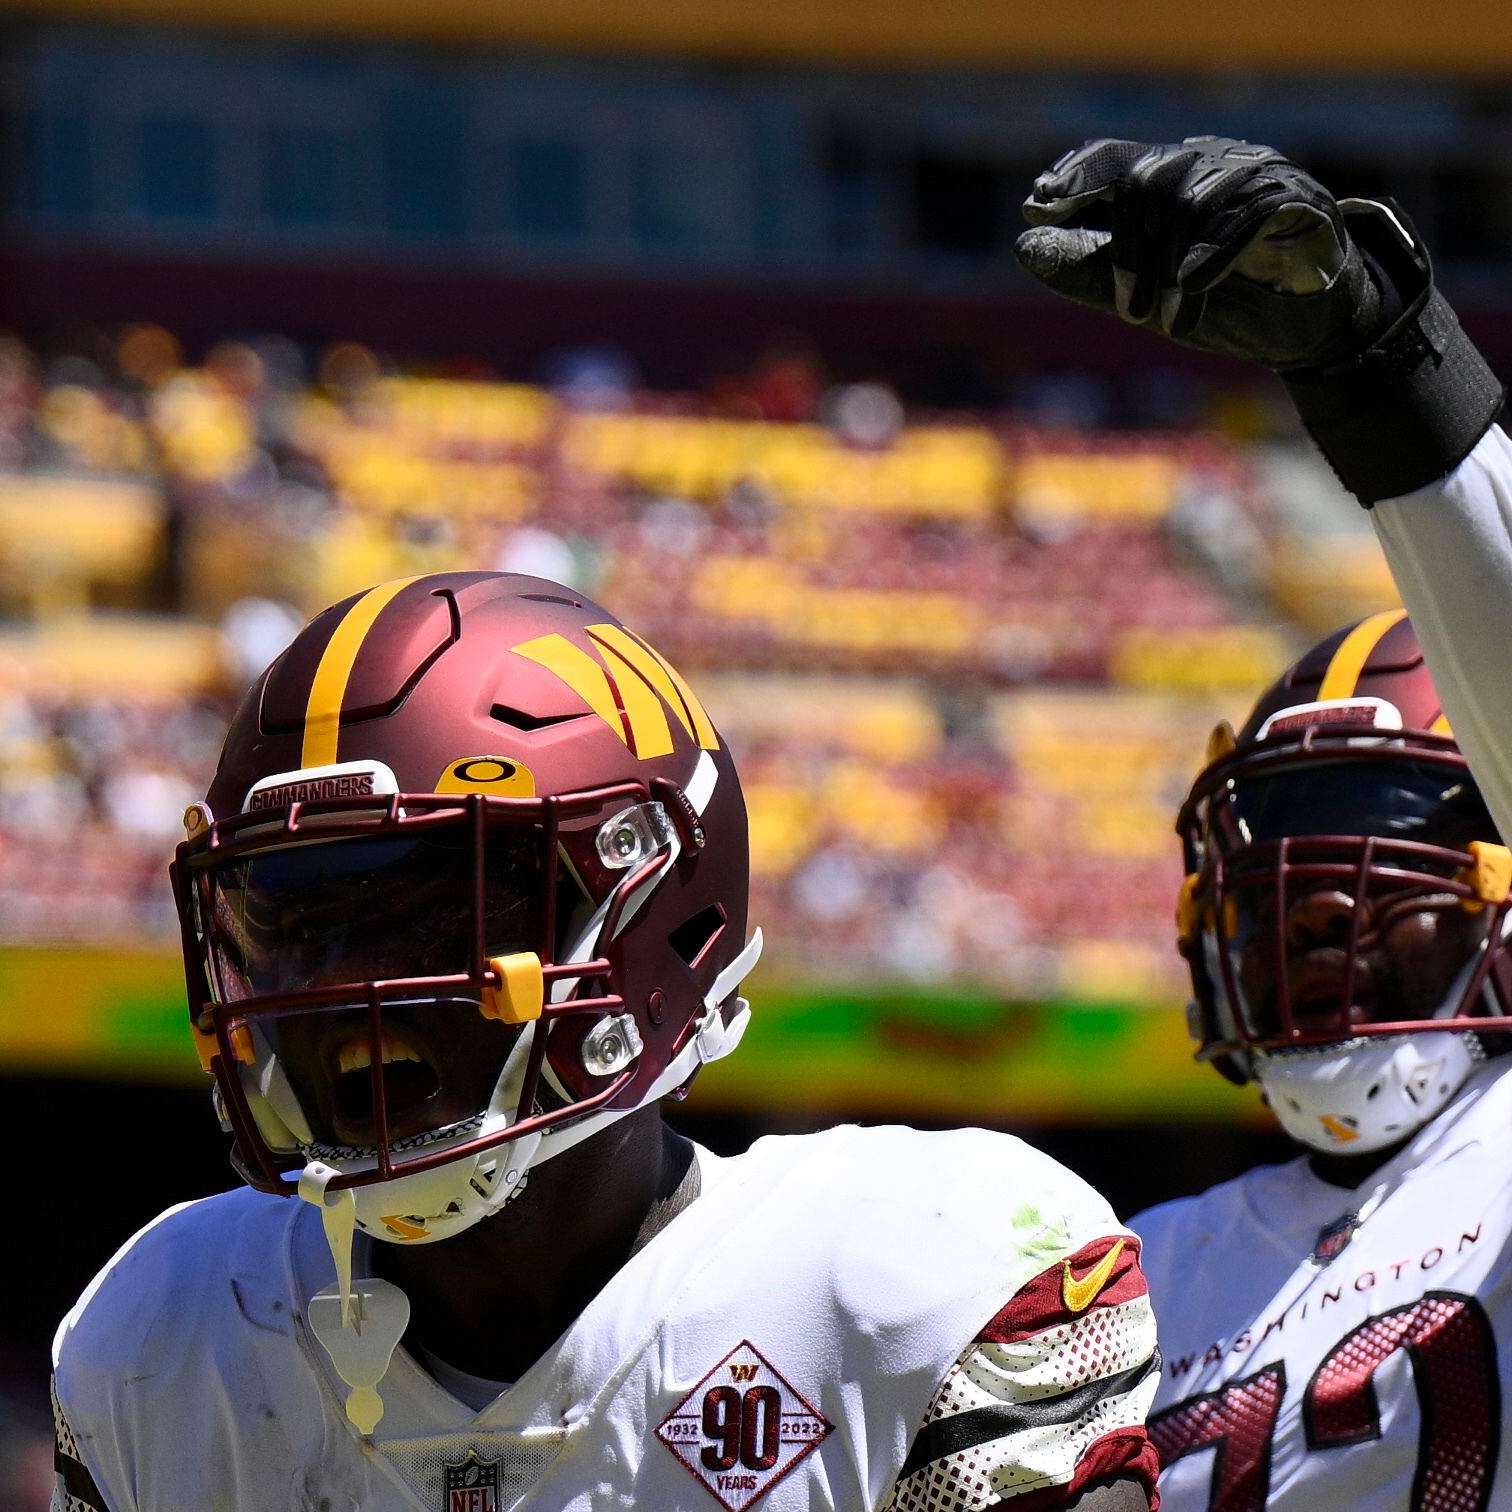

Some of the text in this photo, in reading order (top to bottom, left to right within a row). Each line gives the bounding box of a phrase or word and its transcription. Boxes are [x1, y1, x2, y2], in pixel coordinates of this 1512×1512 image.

[250, 774, 375, 811] COMMANDERS
[1169, 1222, 1482, 1380] WASHINGTON
[666, 1423, 698, 1436] 1932
[701, 1385, 781, 1471] 90
[782, 1422, 820, 1434] 2022
[717, 1475, 758, 1490] YEARS
